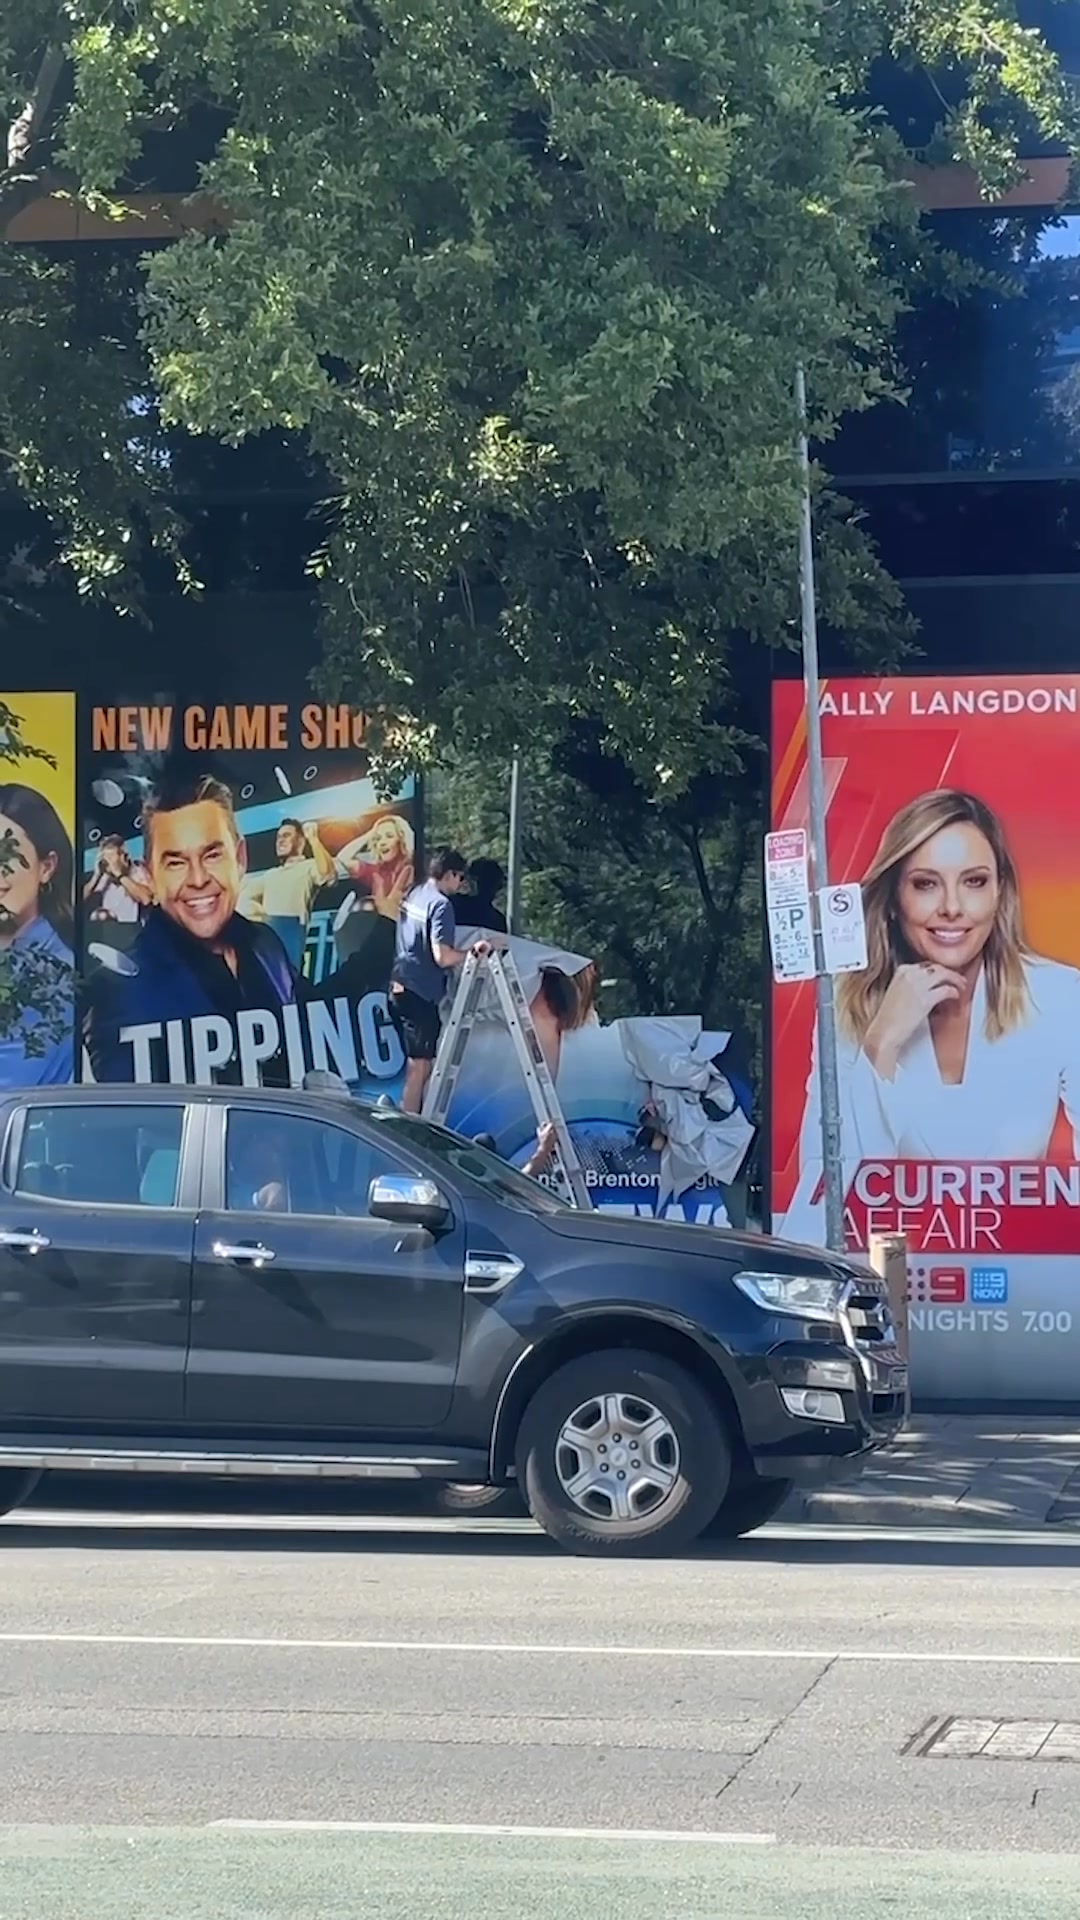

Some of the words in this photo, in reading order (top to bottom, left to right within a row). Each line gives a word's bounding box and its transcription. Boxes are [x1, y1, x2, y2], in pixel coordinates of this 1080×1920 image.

[819, 690, 894, 717] ALLY
[910, 687, 1077, 715] LANGDON
[92, 706, 173, 752] NEW
[184, 704, 289, 751] GAME
[119, 990, 406, 1085] TIPPING
[585, 1169, 661, 1188] Brenton
[843, 1207, 1003, 1251] AFFAIR
[908, 1309, 1009, 1332] NIGHTS
[1021, 1310, 1072, 1334] 7.00
